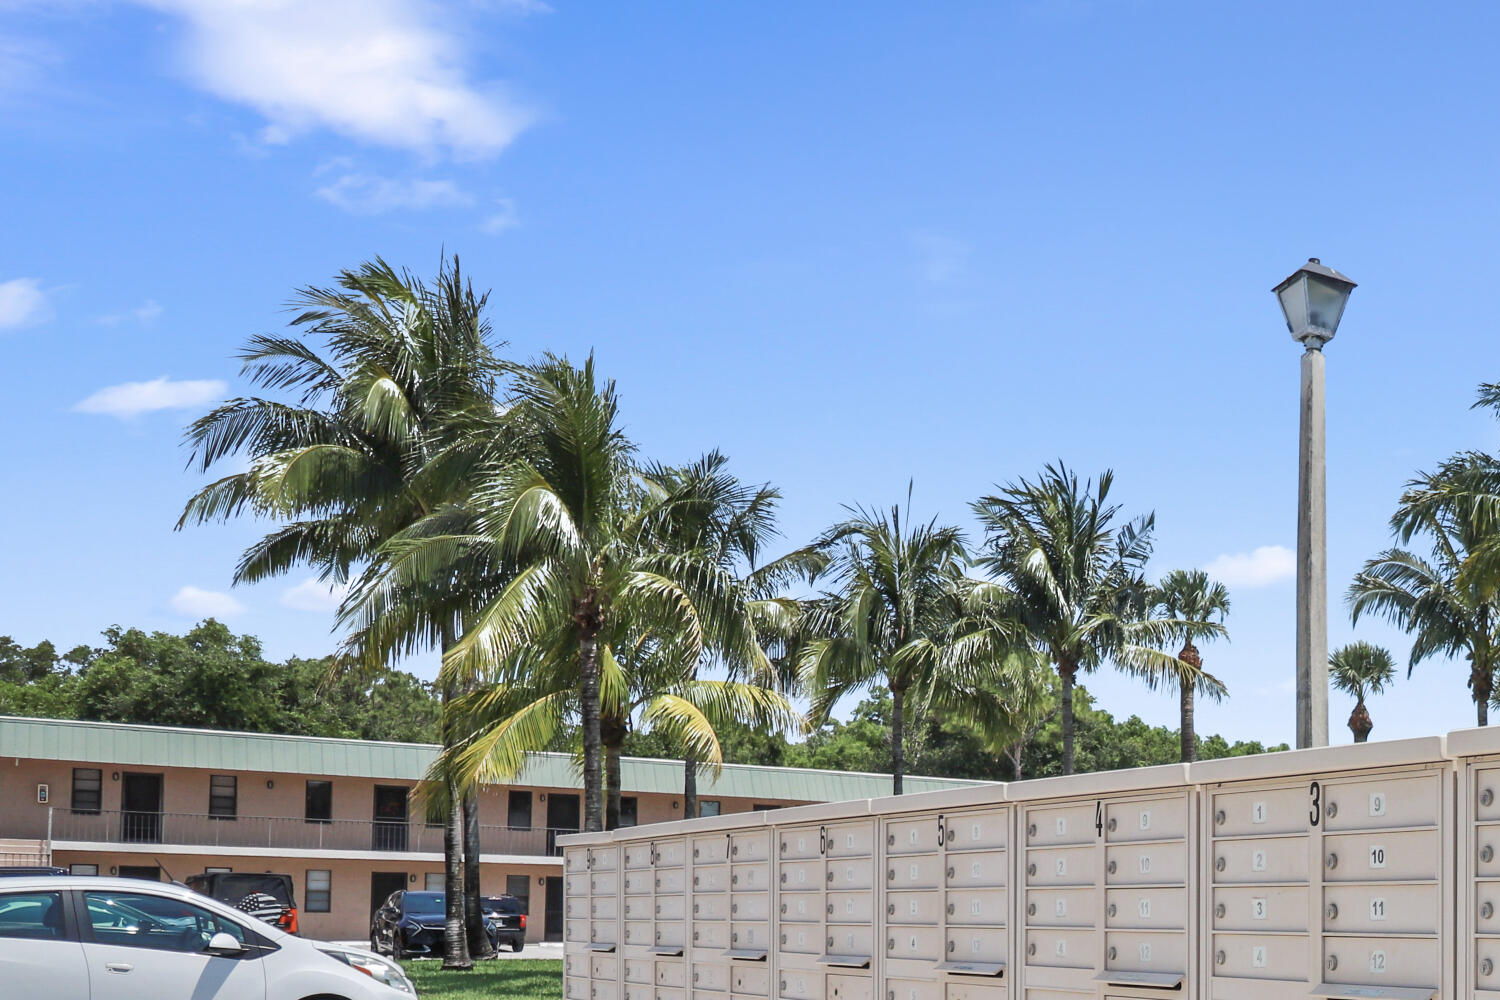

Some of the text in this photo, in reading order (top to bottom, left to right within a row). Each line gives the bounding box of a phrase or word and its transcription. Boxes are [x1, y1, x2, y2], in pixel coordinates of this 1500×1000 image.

[1309, 782, 1320, 826] 3
[1374, 797, 1381, 812] 9
[1095, 801, 1103, 837] 4
[1257, 806, 1262, 819] 1
[938, 815, 944, 847] 5
[726, 834, 730, 859] 7
[820, 826, 826, 855] 6
[587, 848, 591, 869] 9
[651, 842, 655, 865] 8
[1256, 854, 1263, 867] 2
[1371, 849, 1384, 864] 10
[1257, 902, 1263, 915] 3
[1372, 901, 1384, 916] 11
[1256, 950, 1263, 963] 4
[1372, 954, 1384, 969] 12
